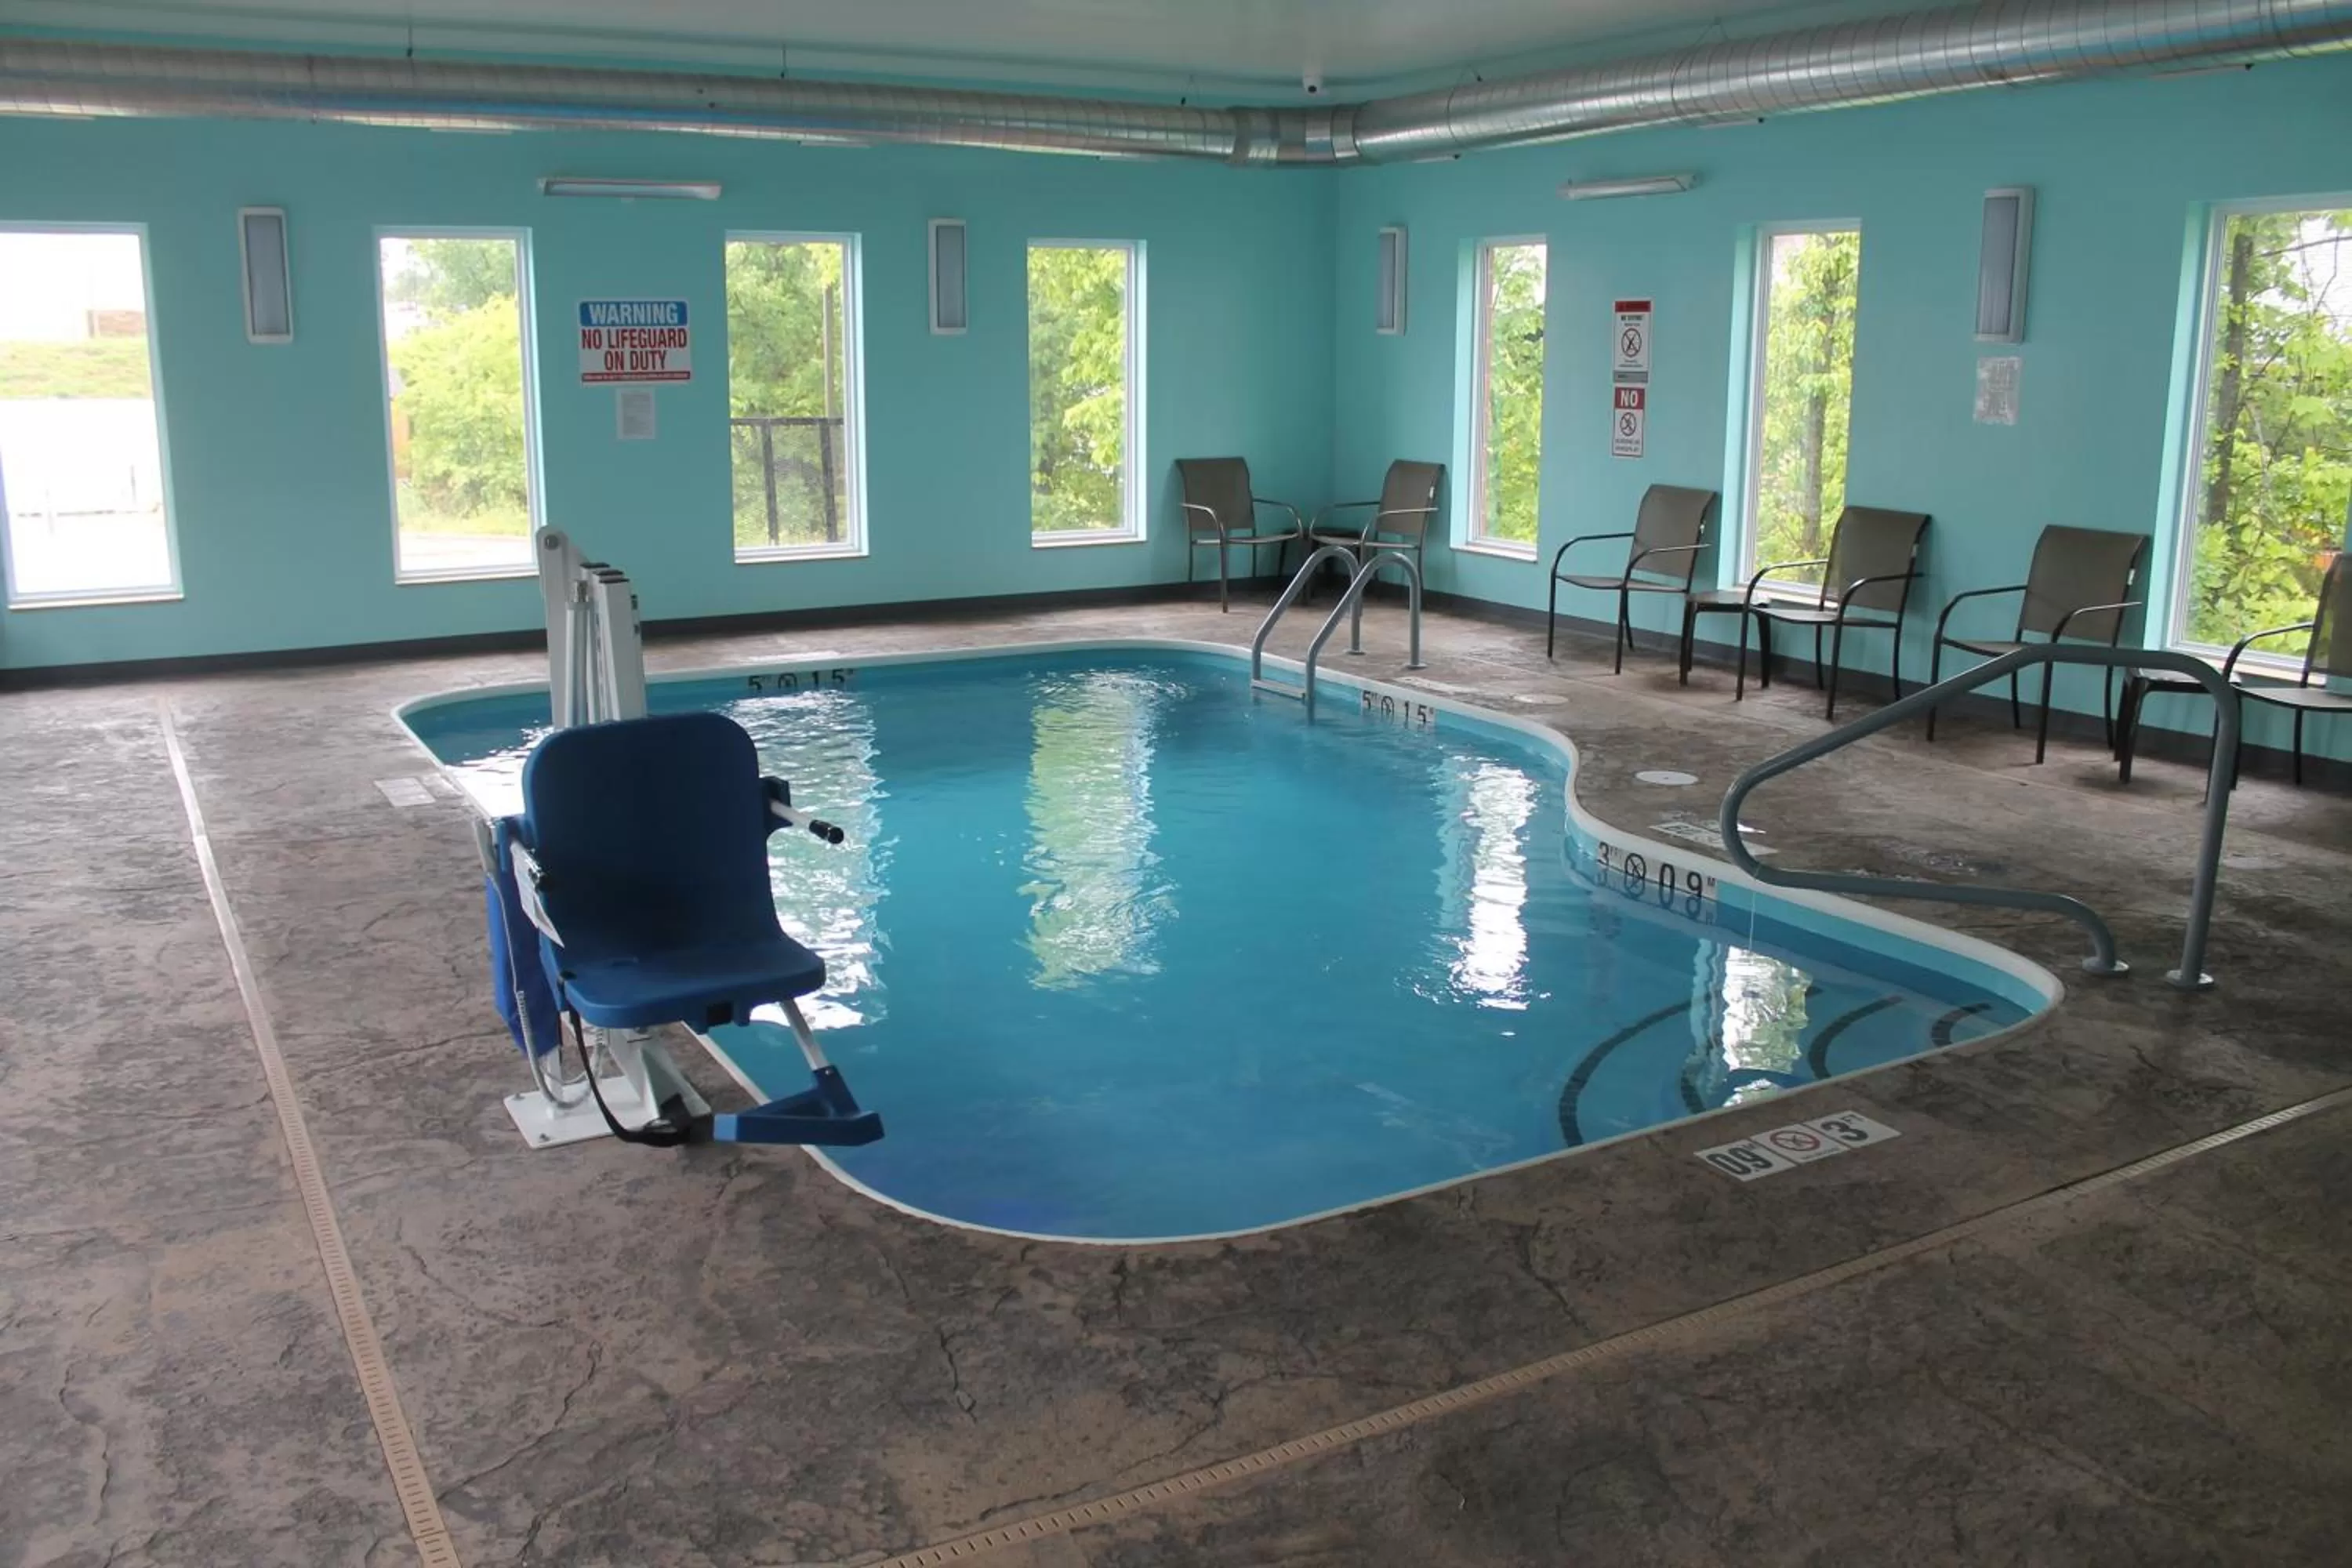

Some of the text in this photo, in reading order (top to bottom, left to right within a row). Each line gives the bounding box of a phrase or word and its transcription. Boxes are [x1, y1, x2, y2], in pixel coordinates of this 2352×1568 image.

[589, 303, 678, 325] WARNING
[582, 328, 687, 350] NO LIFEGUARD
[604, 350, 668, 371] ON DUTY
[1620, 389, 1639, 408] NO
[1820, 1120, 1870, 1142] 3
